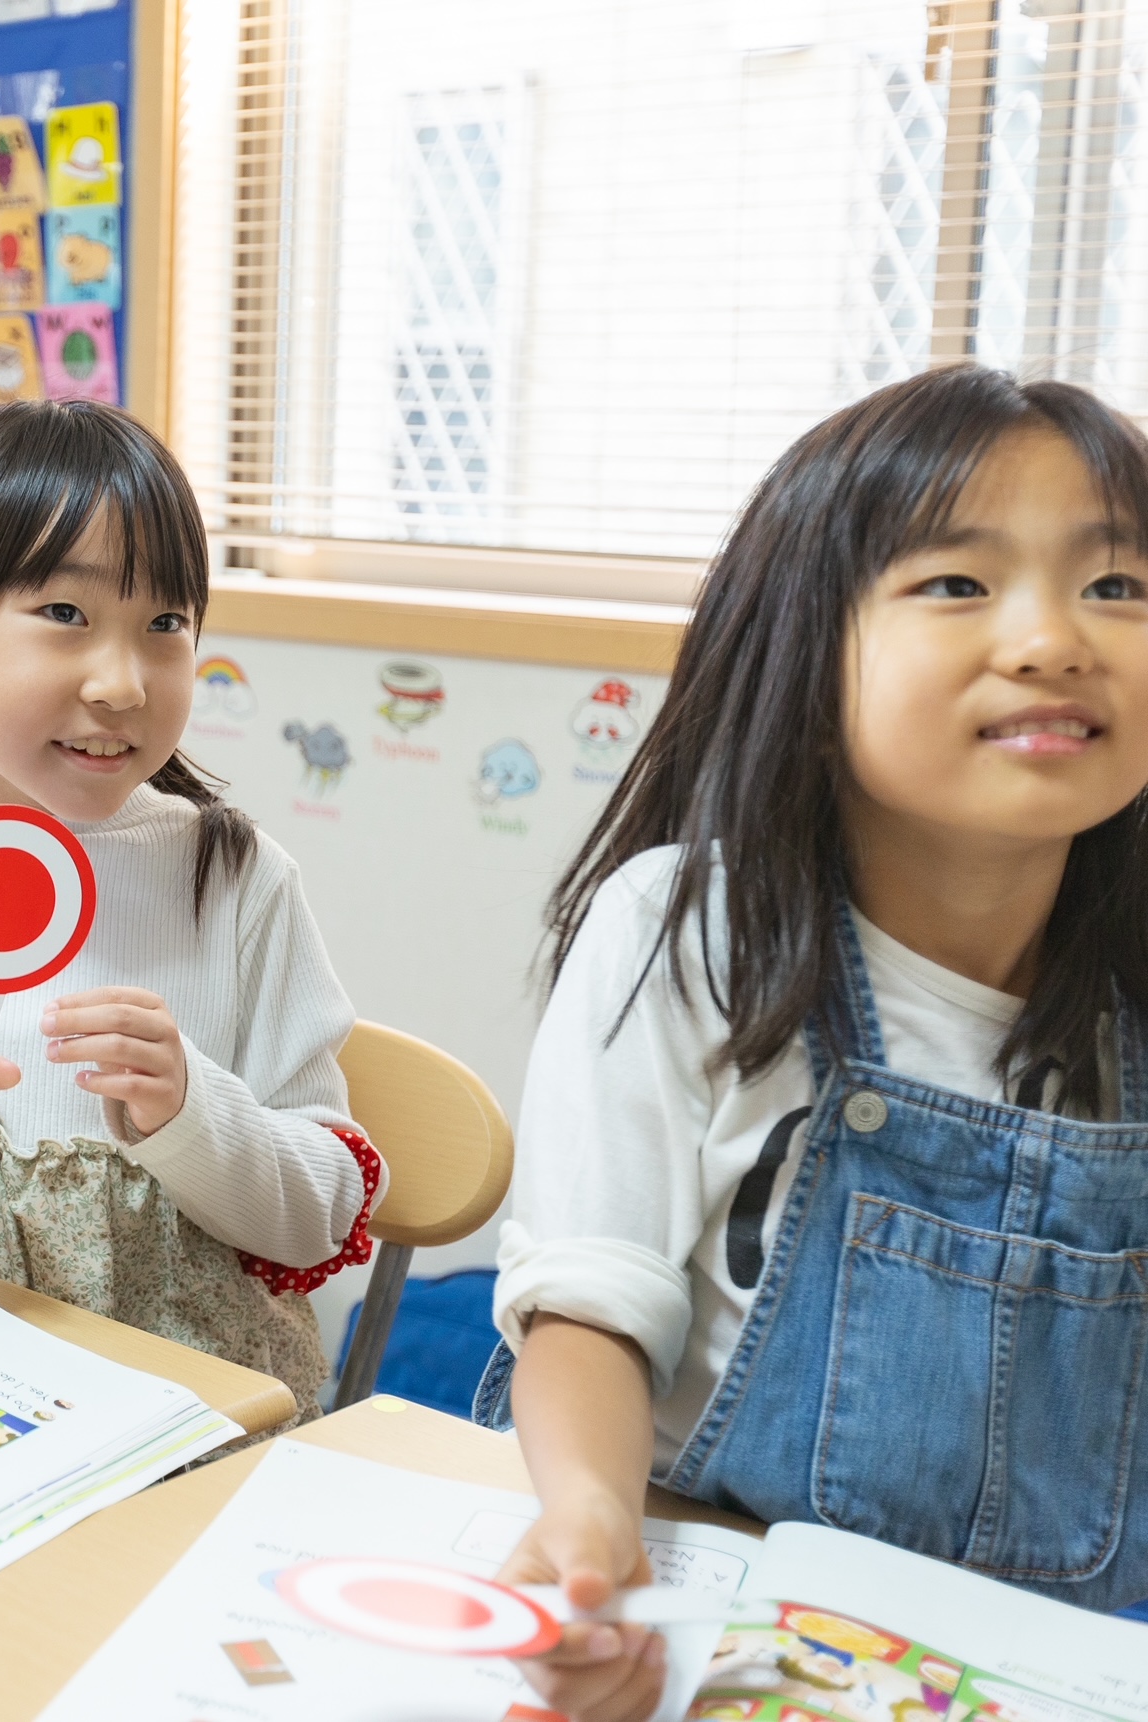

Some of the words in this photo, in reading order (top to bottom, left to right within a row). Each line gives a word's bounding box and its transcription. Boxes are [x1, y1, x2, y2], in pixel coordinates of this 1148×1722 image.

[372, 735, 441, 763] Typhoon
[572, 766, 622, 784] Snow
[14, 1399, 33, 1413] Do
[254, 1541, 292, 1556] rice
[226, 1611, 328, 1640] chocolate
